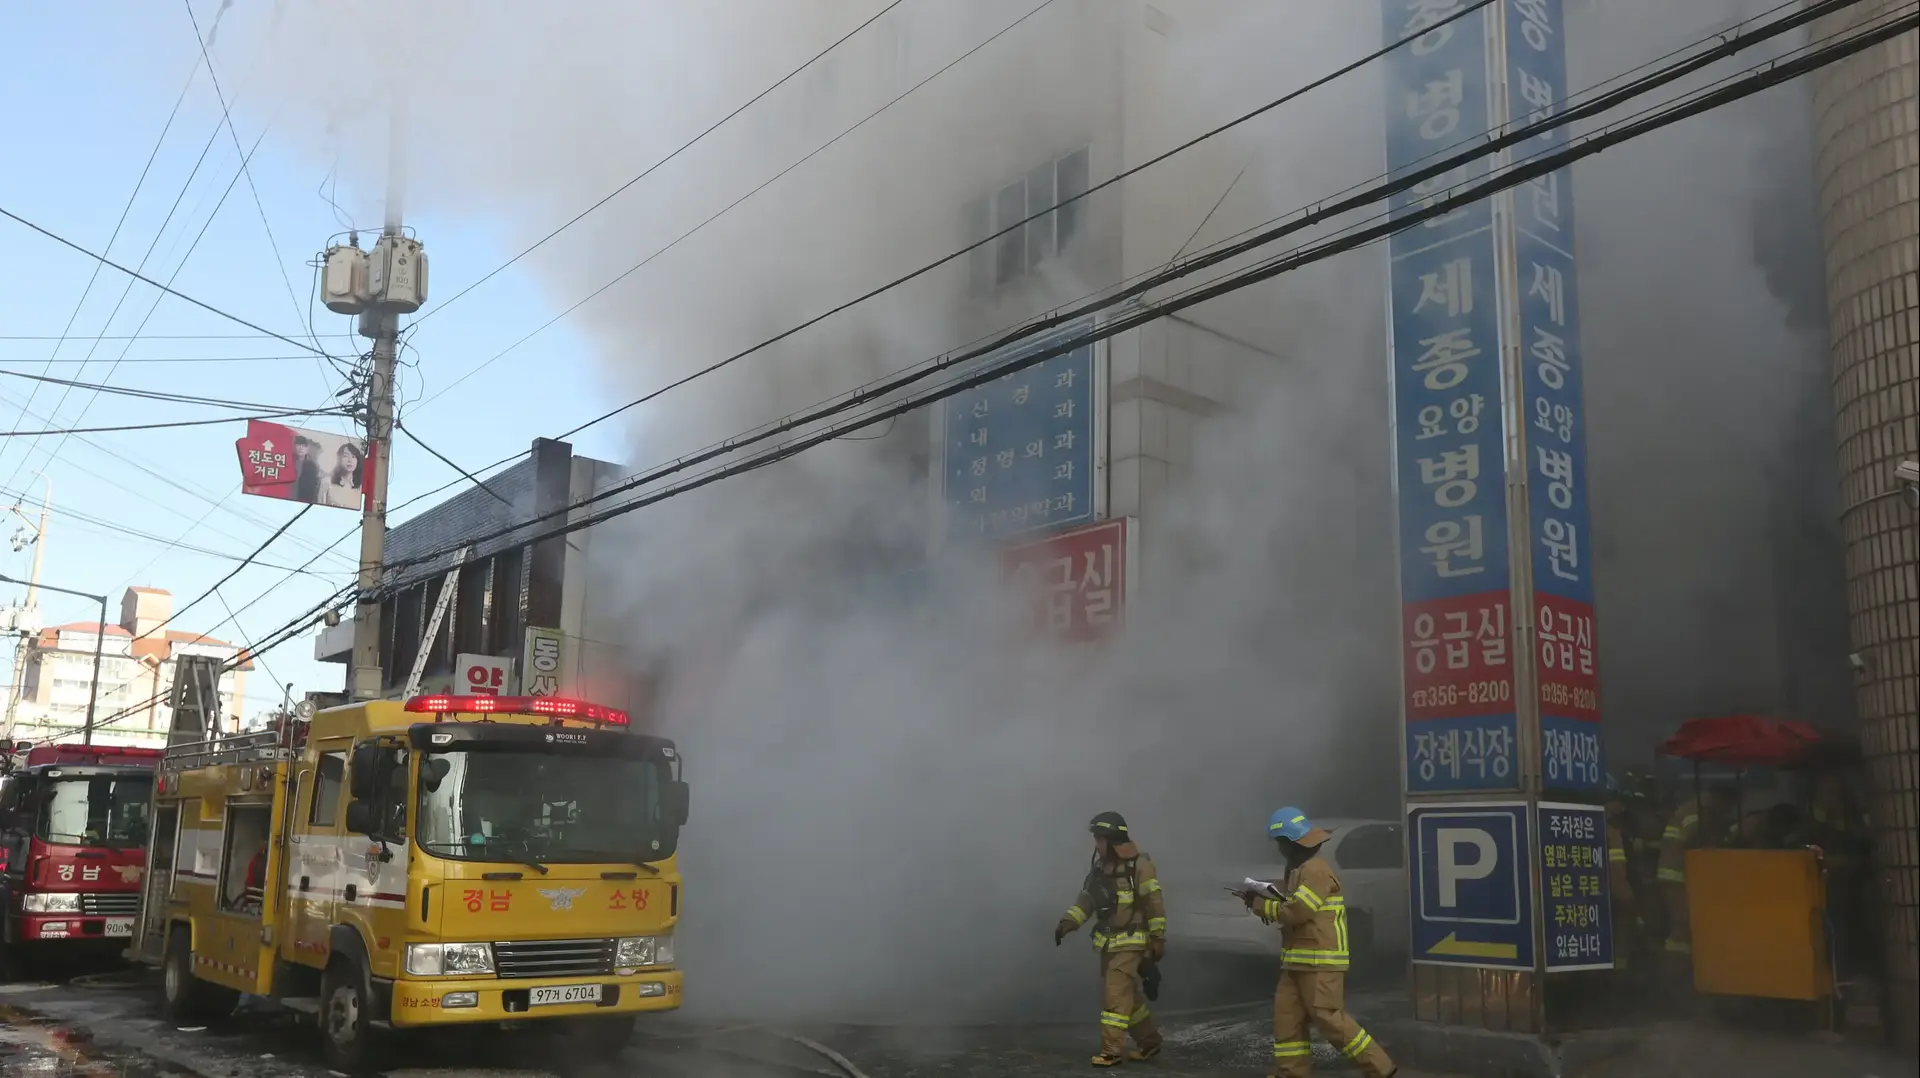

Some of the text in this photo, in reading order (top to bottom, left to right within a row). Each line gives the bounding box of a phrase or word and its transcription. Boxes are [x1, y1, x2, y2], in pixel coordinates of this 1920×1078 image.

[248, 449, 287, 468] 전도연
[254, 466, 279, 480] 거리
[1410, 603, 1507, 673] 응급실
[1538, 605, 1595, 675] 응급실
[1429, 680, 1510, 707] 356-8200
[1550, 683, 1597, 710] 356-8200
[1412, 726, 1513, 782] 장례식장
[1544, 729, 1600, 784] 장례식장
[1550, 815, 1595, 839] 주차장은
[58, 864, 101, 881] 경남
[1437, 827, 1498, 908] P
[1550, 874, 1603, 898] 넓은 무료
[463, 889, 650, 913] 경남 소방
[1554, 903, 1600, 928] 주차장이
[1556, 934, 1601, 959] 있습니다
[420, 996, 440, 1008] 소방
[536, 987, 596, 1002] 97거 6704
